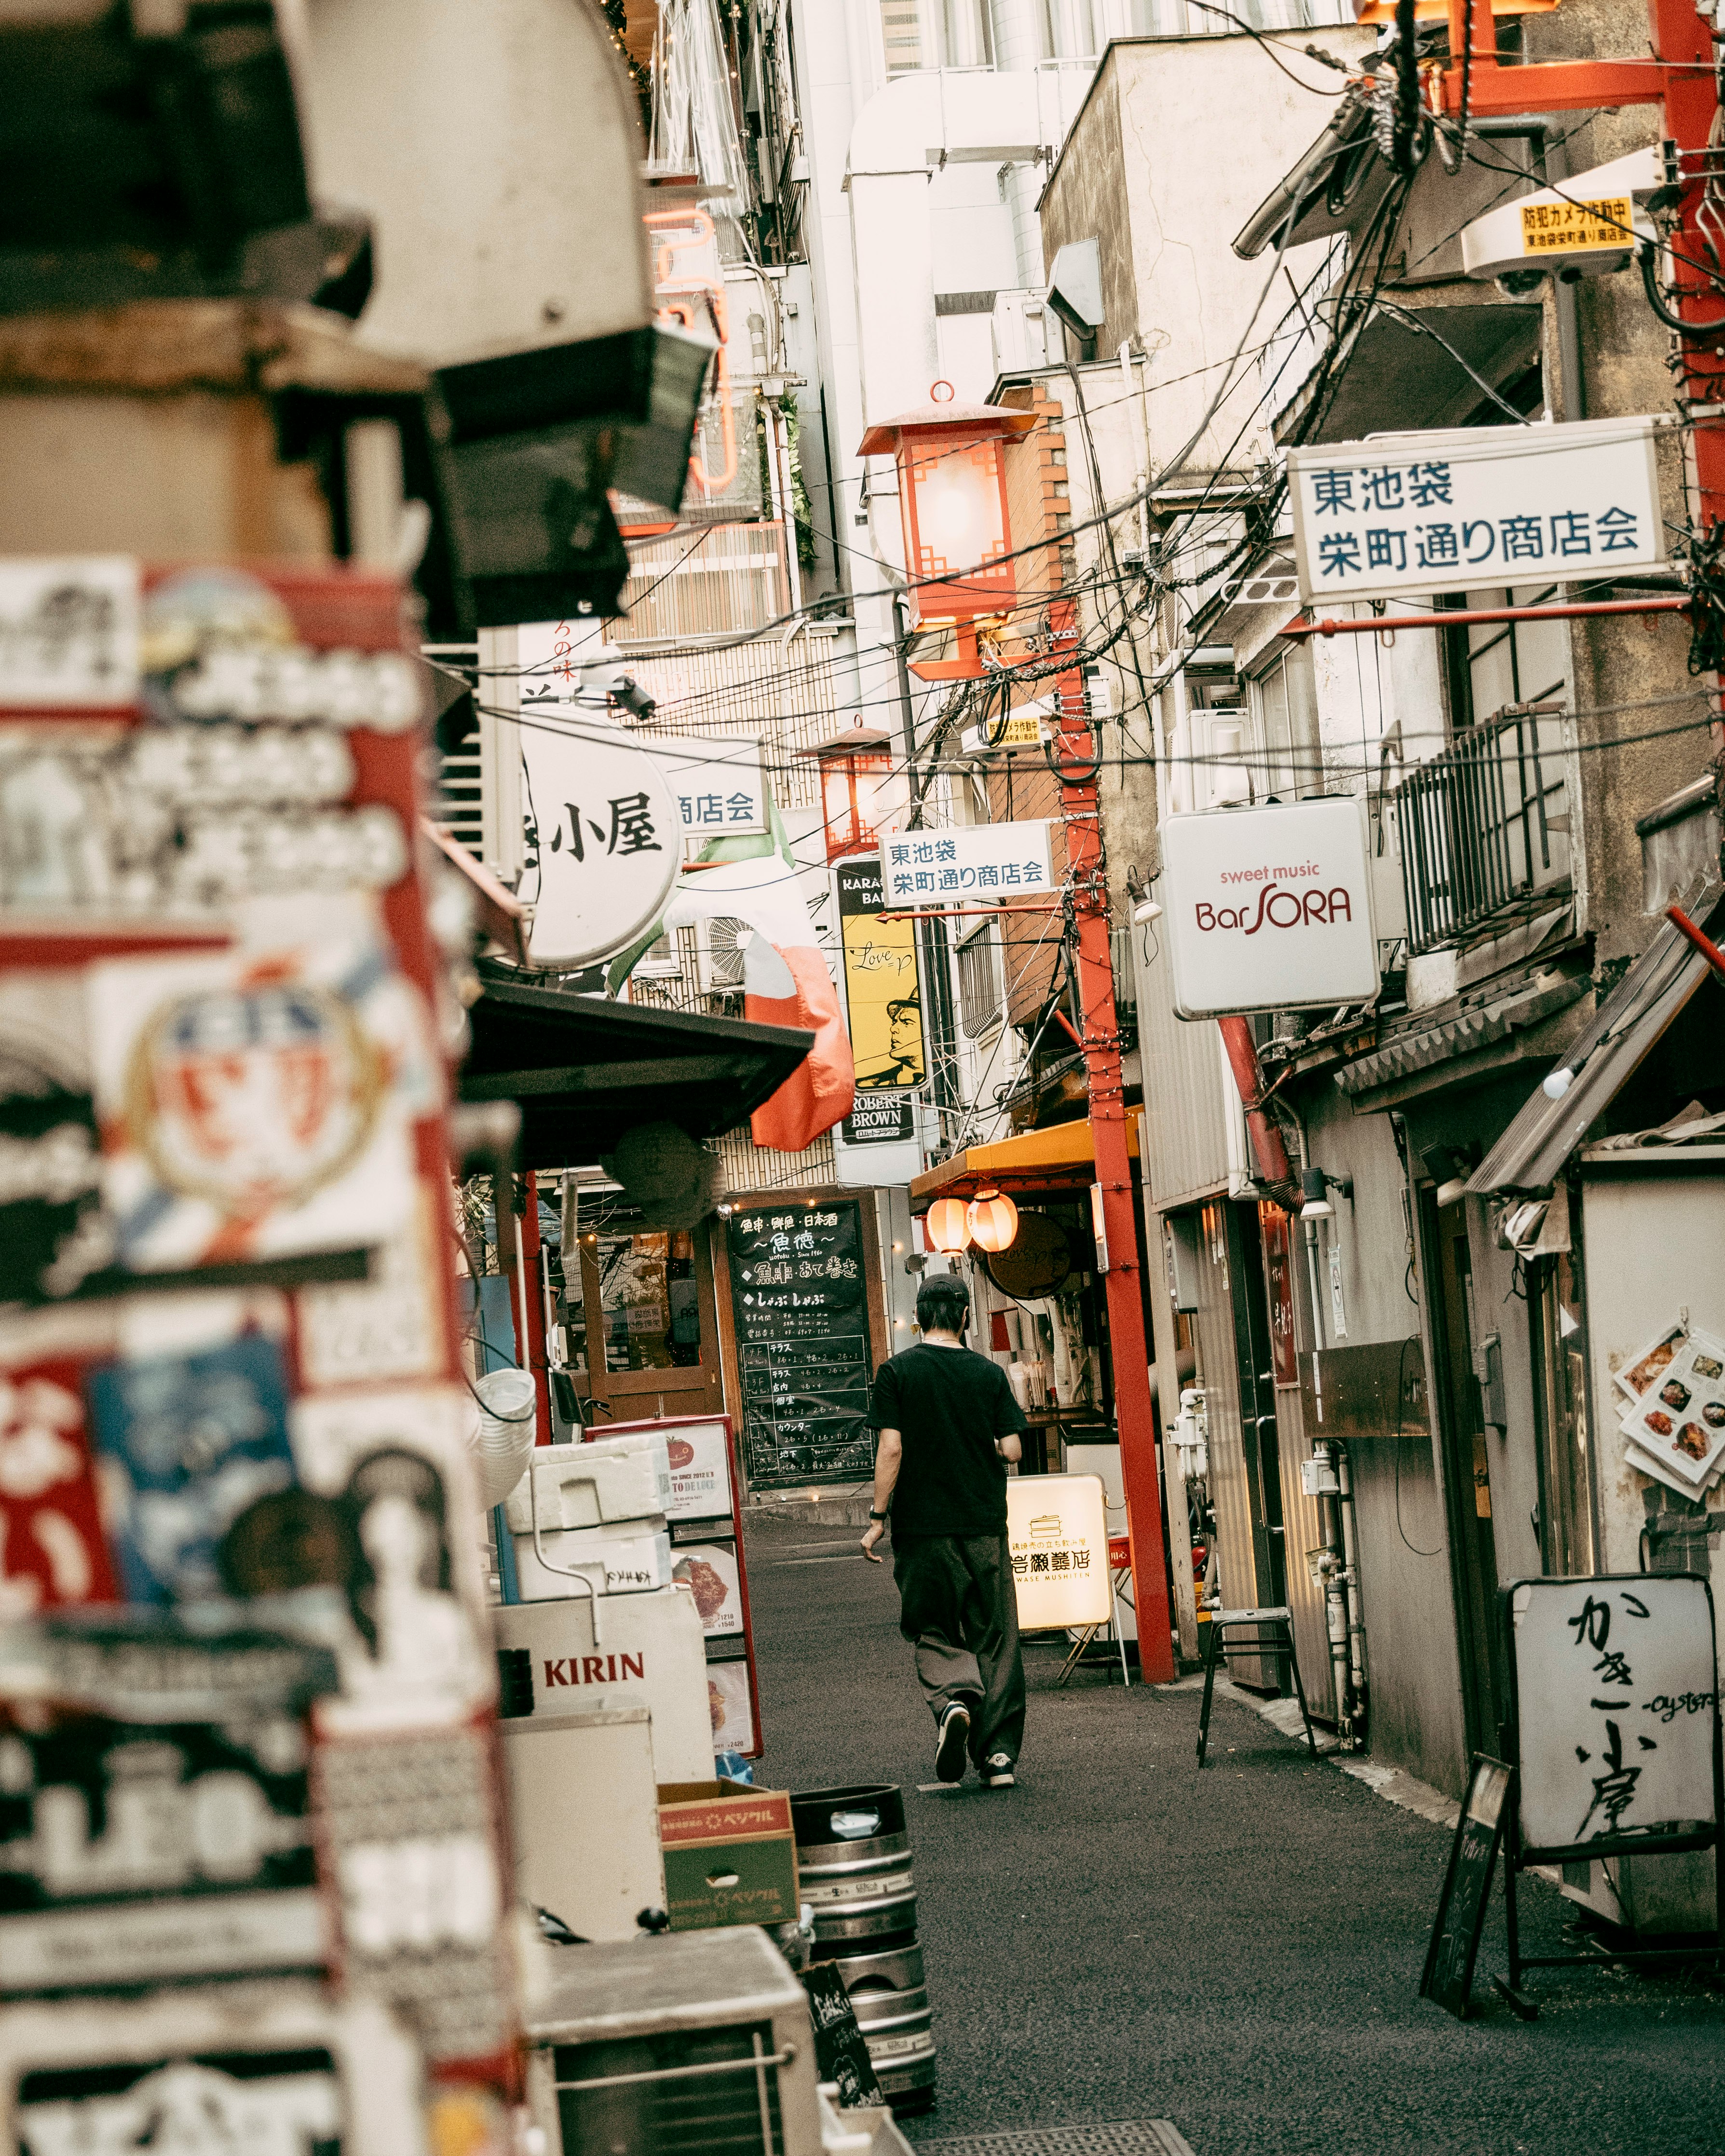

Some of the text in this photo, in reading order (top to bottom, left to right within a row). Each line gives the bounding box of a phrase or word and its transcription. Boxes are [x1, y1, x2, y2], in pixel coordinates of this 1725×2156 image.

[1523, 199, 1626, 230] 防犯カメラ作動中
[1310, 461, 1453, 516] 東池袋
[1318, 506, 1639, 578] 栄町通り商店会
[990, 721, 1037, 735] 防メラ作動中
[889, 839, 957, 866] 東池袋
[893, 860, 1044, 895] 栄町通り商店会
[1220, 860, 1320, 884] sweet music
[842, 877, 883, 890] KARA
[1195, 882, 1352, 936] Bar SORA
[850, 941, 894, 971] Love
[853, 1094, 903, 1112] ROBERT
[851, 1110, 901, 1128] BROWN
[770, 1343, 793, 1353] テラス
[772, 1370, 791, 1379] テラス
[773, 1383, 788, 1393] 店内
[774, 1395, 795, 1406] 個室
[777, 1423, 811, 1432] カウンター
[779, 1449, 797, 1459] 地下
[1045, 1572, 1090, 1581] MUSHITEN
[543, 1652, 645, 1688] KIRIN
